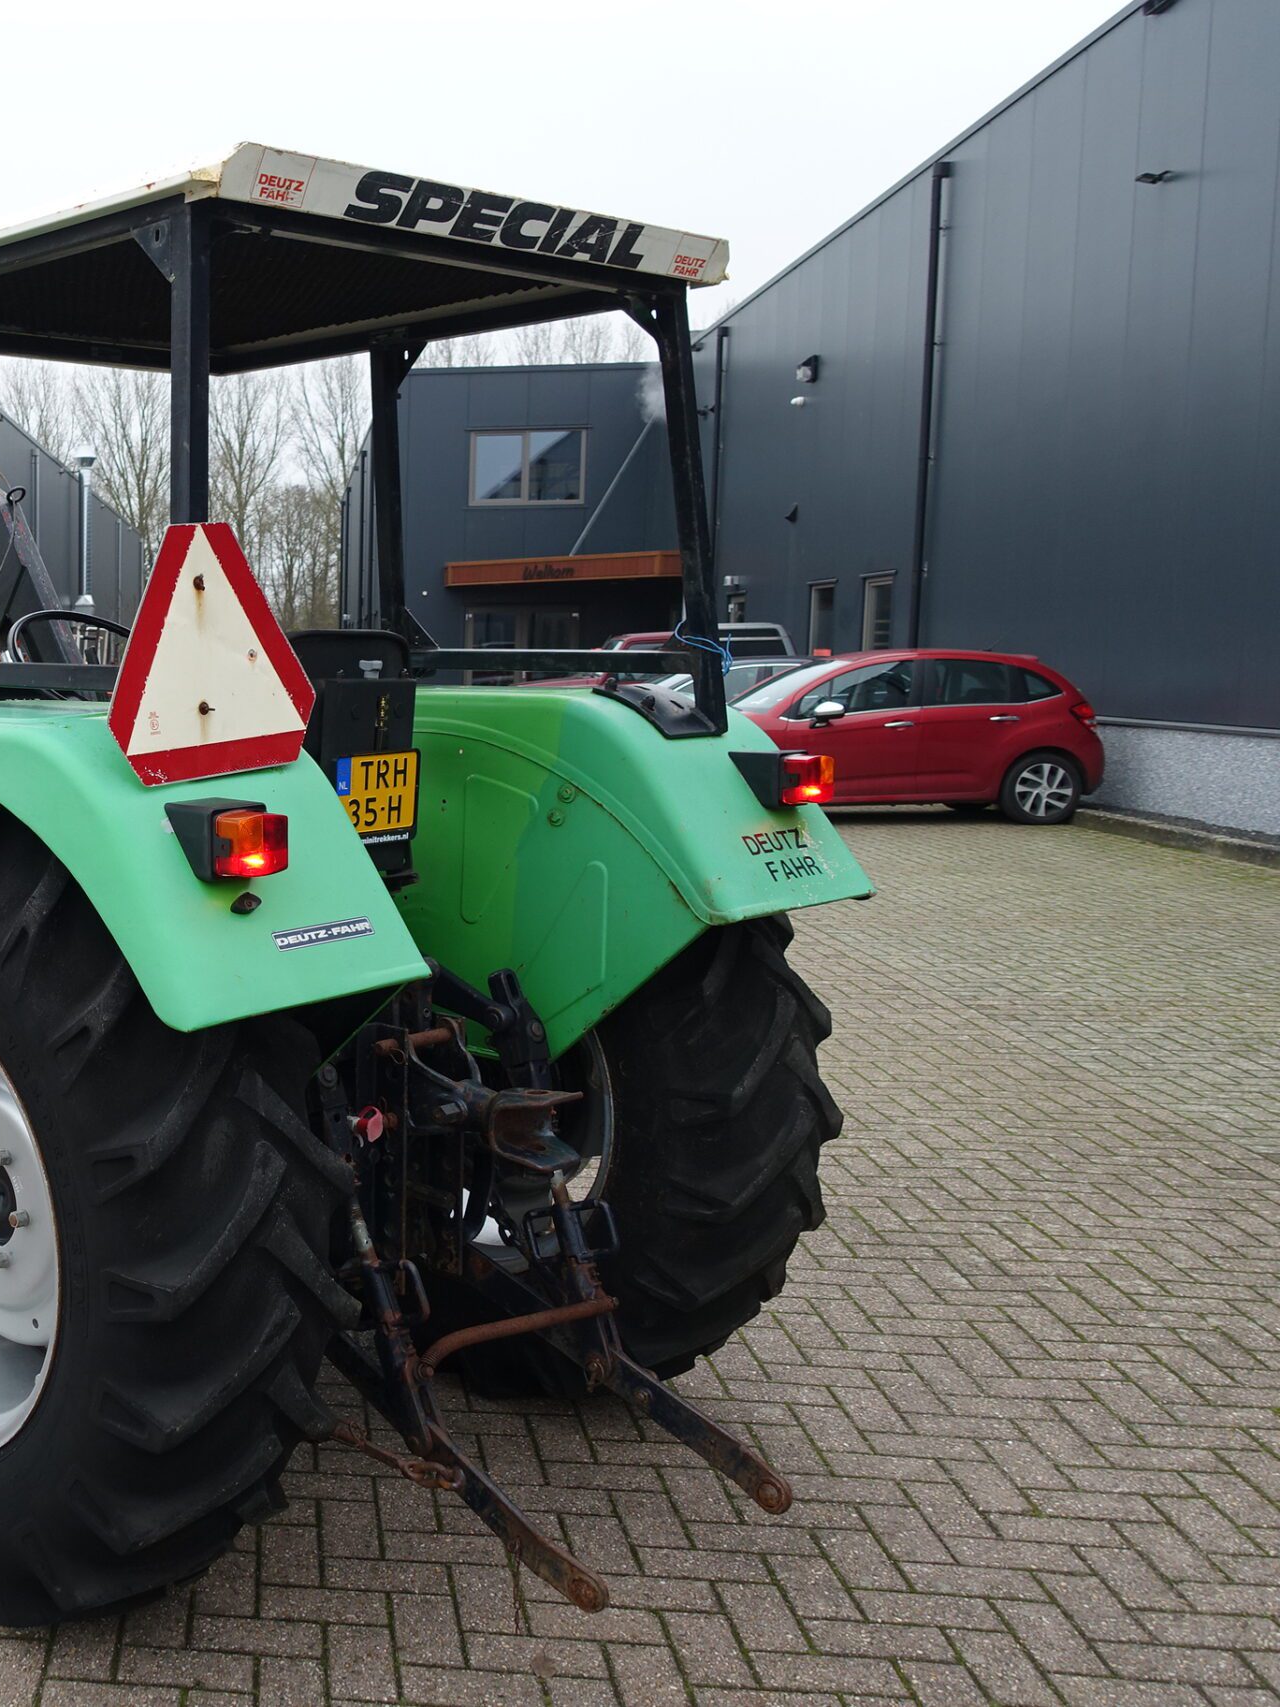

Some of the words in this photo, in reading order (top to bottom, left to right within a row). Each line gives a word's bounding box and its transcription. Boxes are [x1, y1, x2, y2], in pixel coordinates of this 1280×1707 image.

[258, 173, 304, 192] DEUTZ
[343, 170, 644, 269] SPECIAL
[673, 265, 699, 277] FAHR
[674, 254, 706, 268] DEUTZ
[339, 782, 348, 790] NL
[361, 758, 408, 790] TRH
[741, 828, 808, 856] DEUTZ
[765, 856, 823, 882] FAHR
[276, 921, 371, 947] DEUTZ-FAHR
